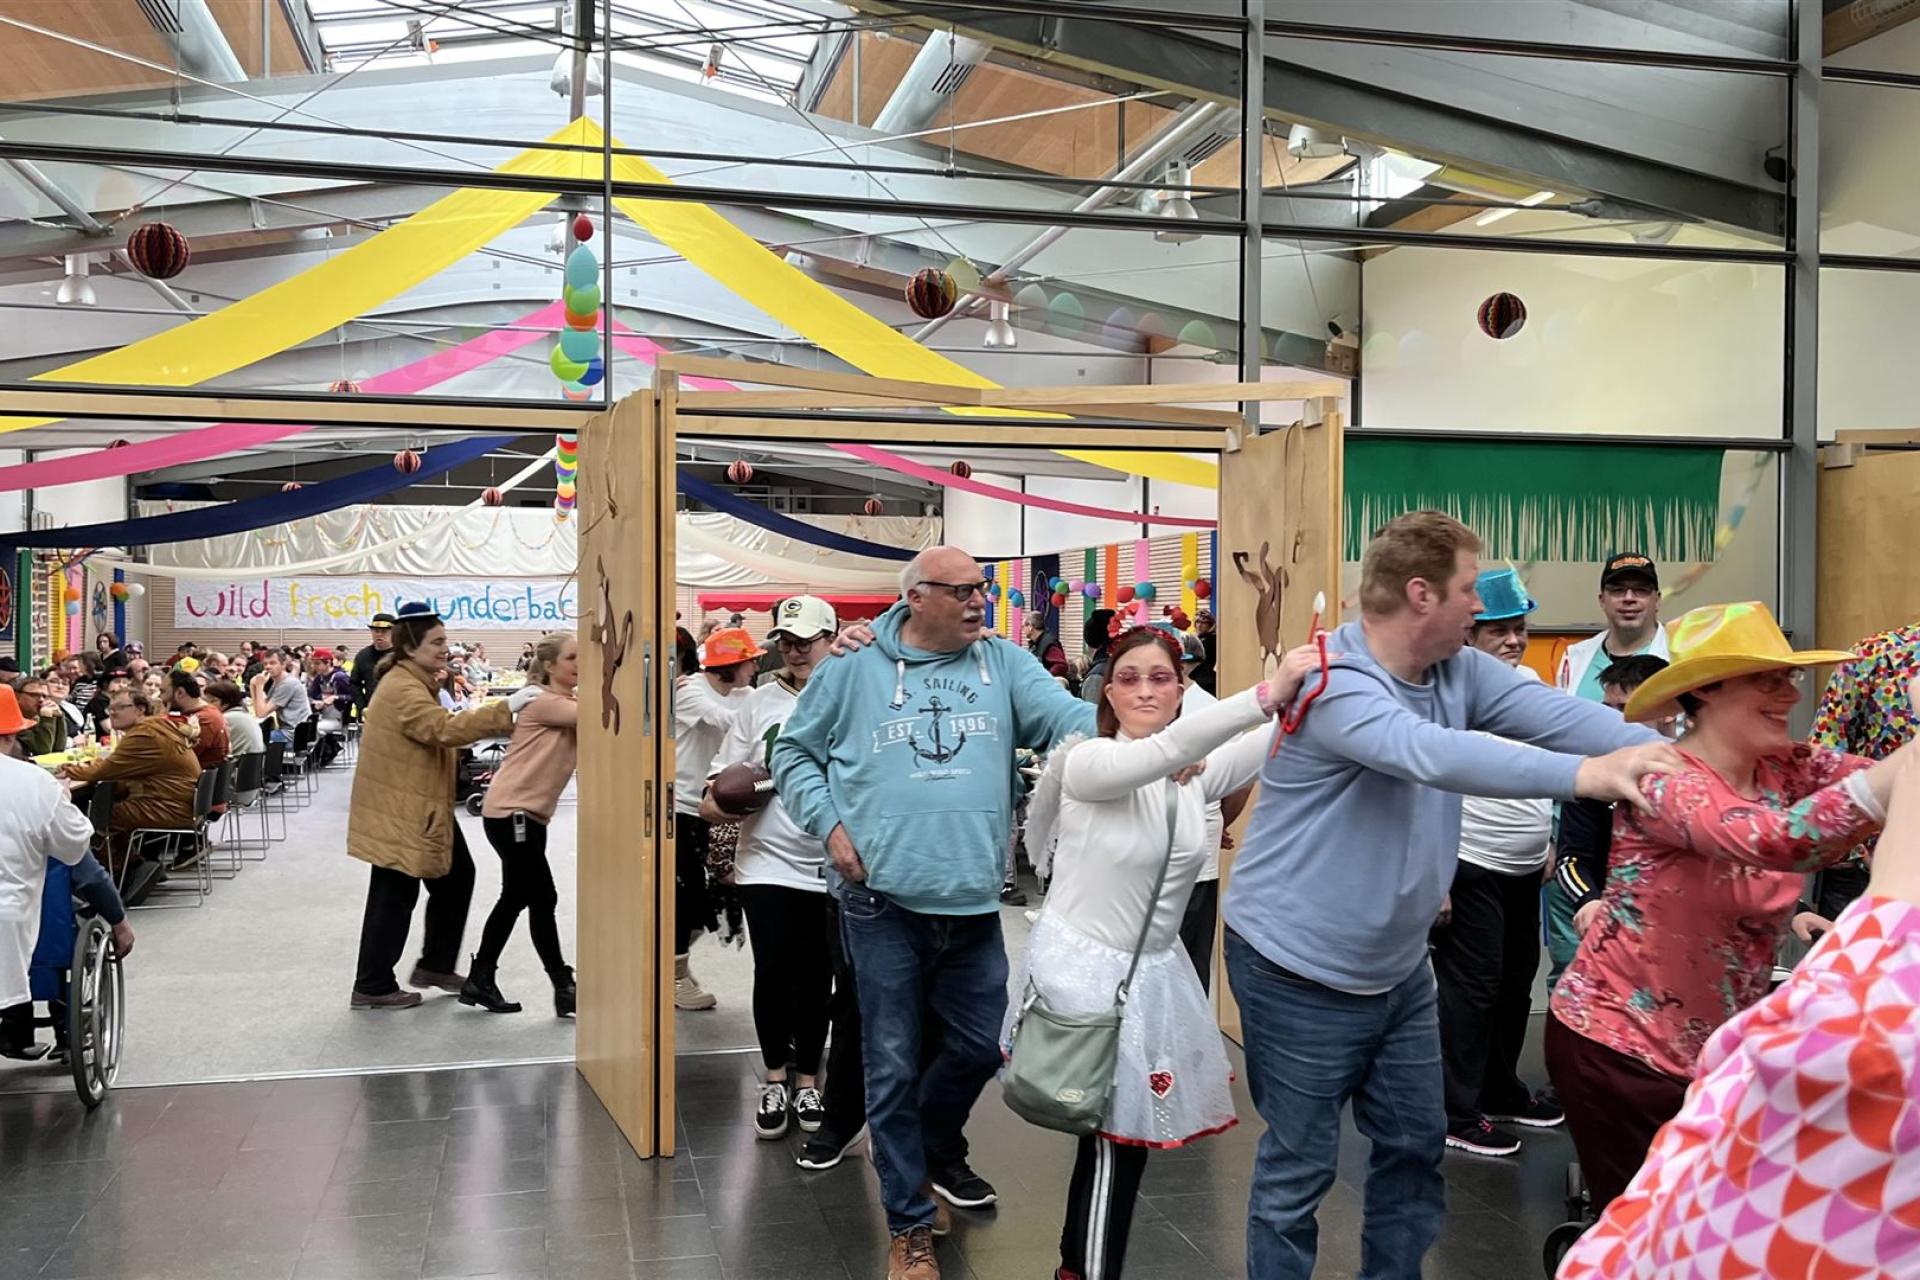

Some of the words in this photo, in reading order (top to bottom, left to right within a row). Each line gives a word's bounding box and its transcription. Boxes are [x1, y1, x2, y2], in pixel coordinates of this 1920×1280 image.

[186, 580, 272, 618] wild
[289, 582, 382, 617] frech
[923, 678, 979, 704] SAILING
[888, 722, 920, 739] EST.
[950, 717, 986, 733] 1996
